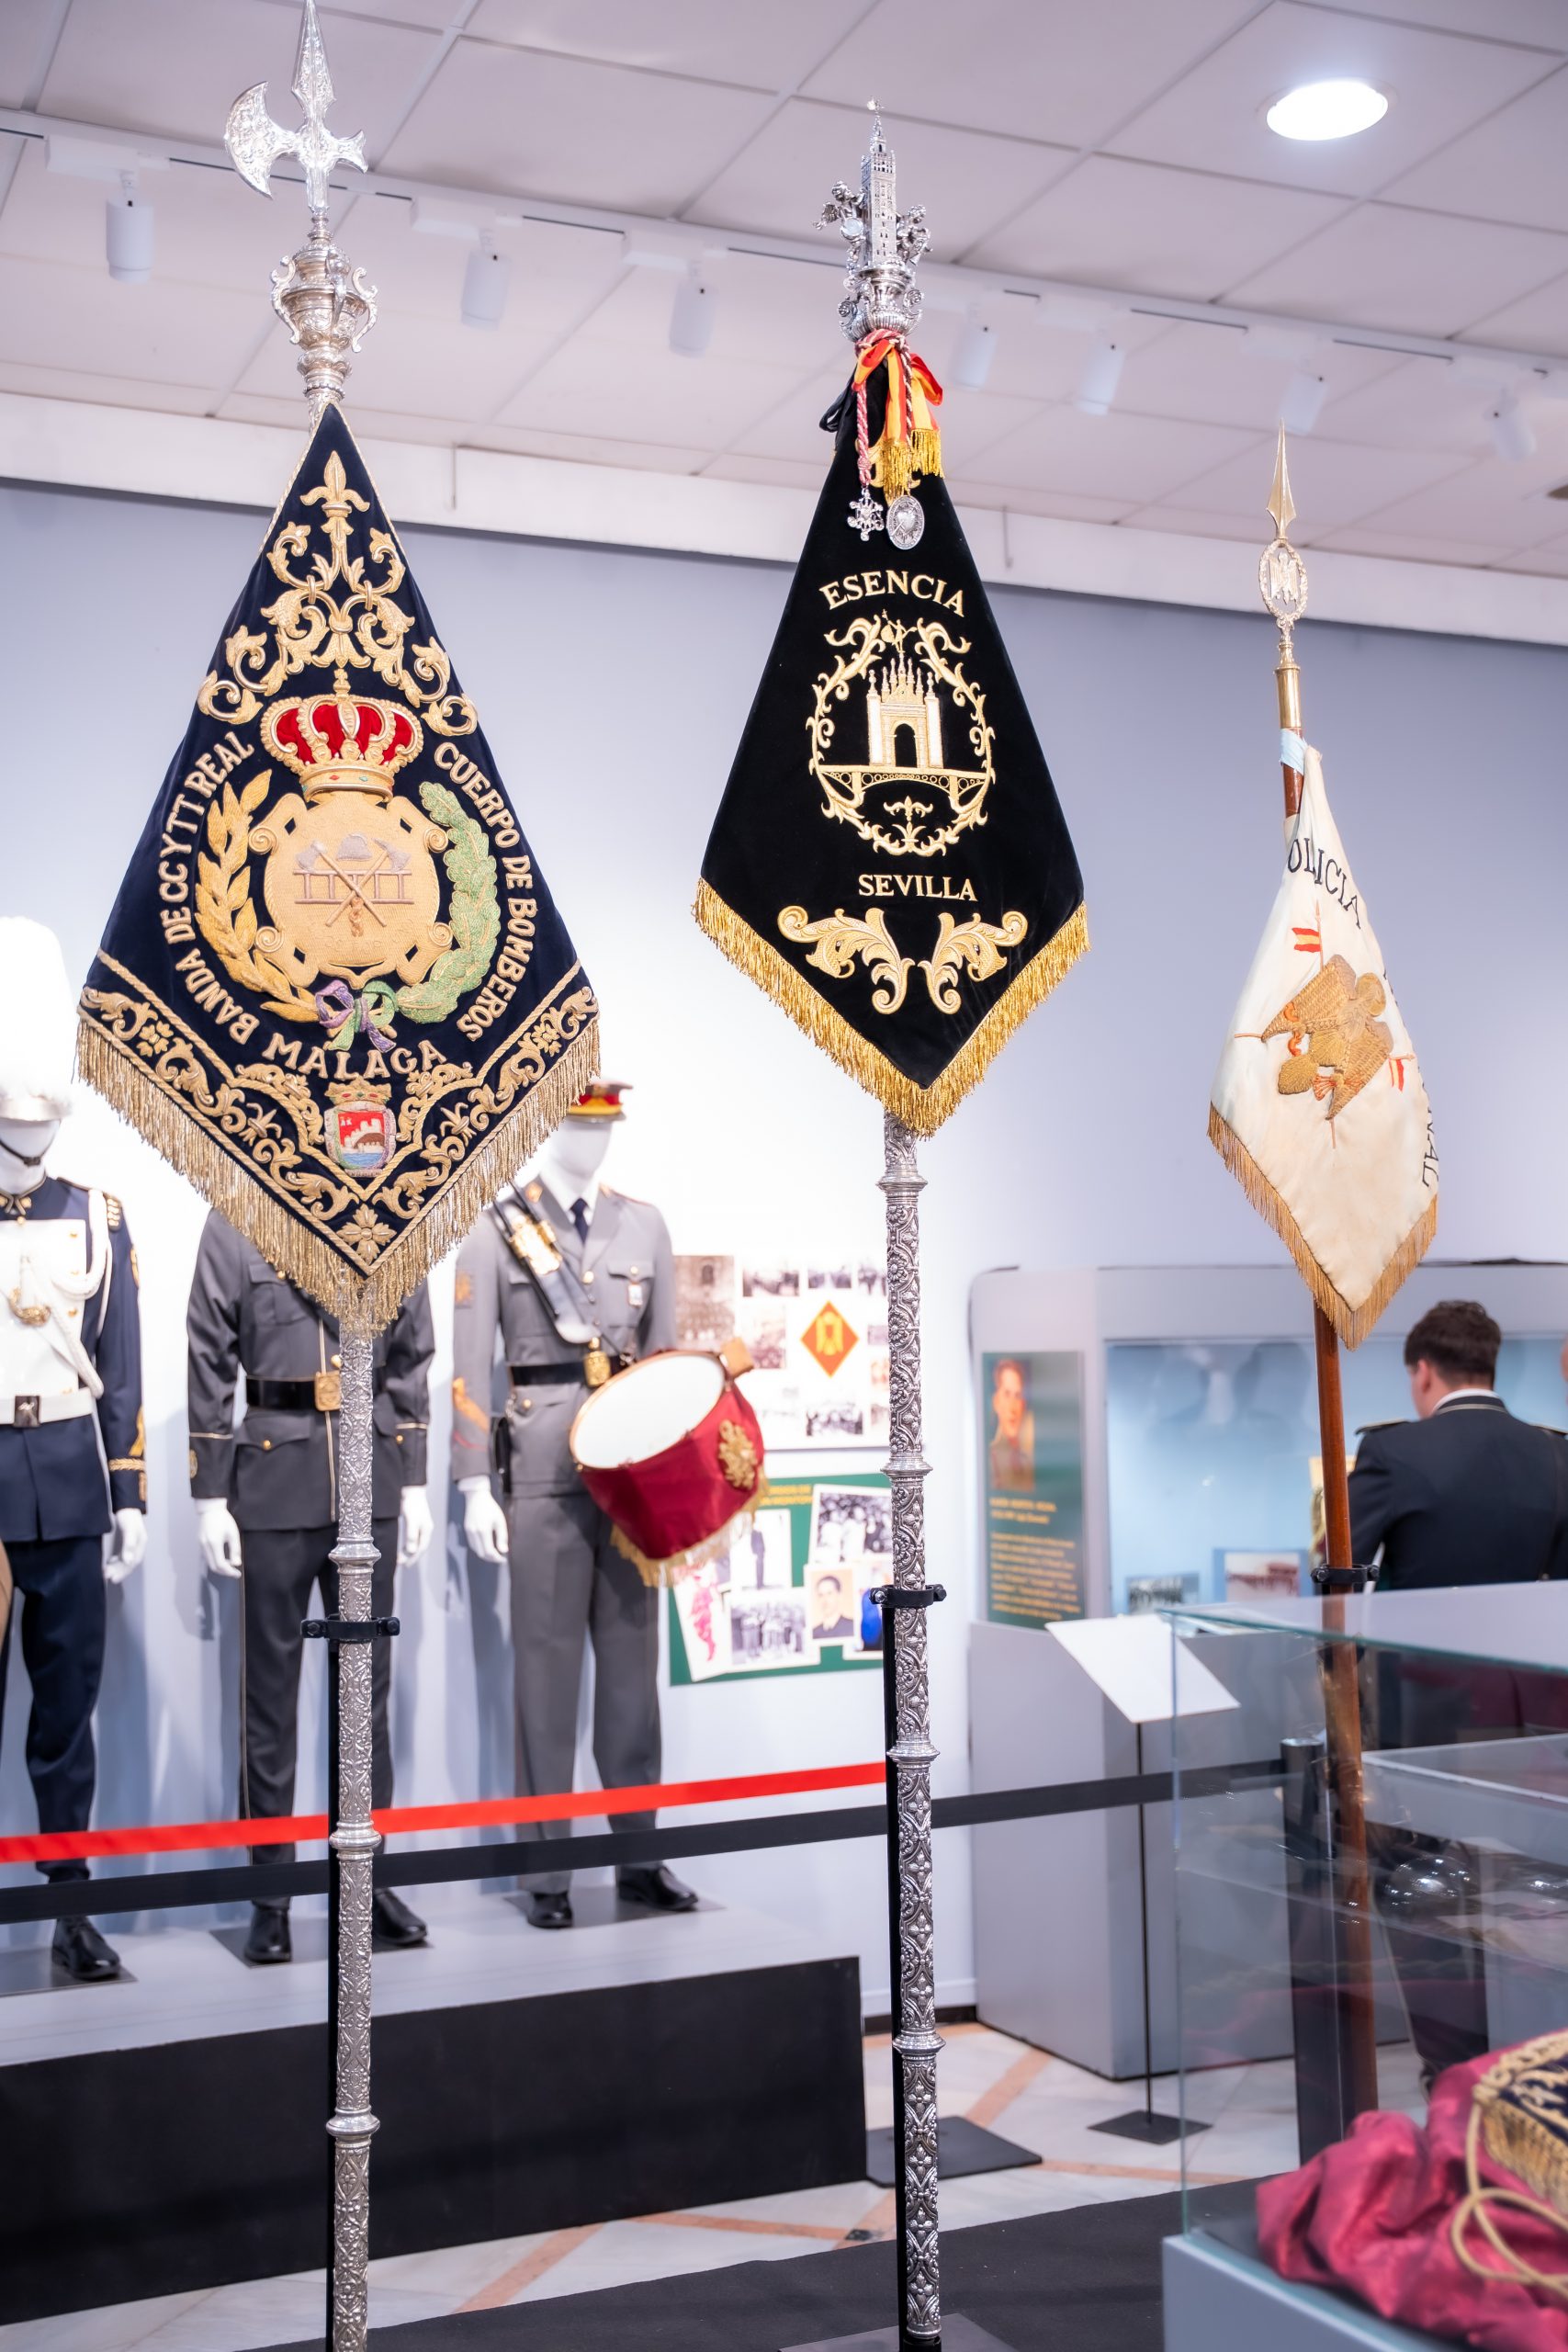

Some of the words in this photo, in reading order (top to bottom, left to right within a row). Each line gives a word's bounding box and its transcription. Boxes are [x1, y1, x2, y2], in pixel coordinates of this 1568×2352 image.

[818, 570, 964, 617] ESENCIA
[185, 731, 255, 798] REAL
[434, 741, 520, 848] CUERPO
[502, 854, 533, 889] DE
[858, 874, 977, 902] SEVILLA
[1288, 837, 1361, 930] OLICIA
[160, 906, 196, 944] DE
[175, 948, 260, 1045] BANDA
[457, 898, 537, 1041] BOMBEROS
[262, 1033, 447, 1080] MALAGA
